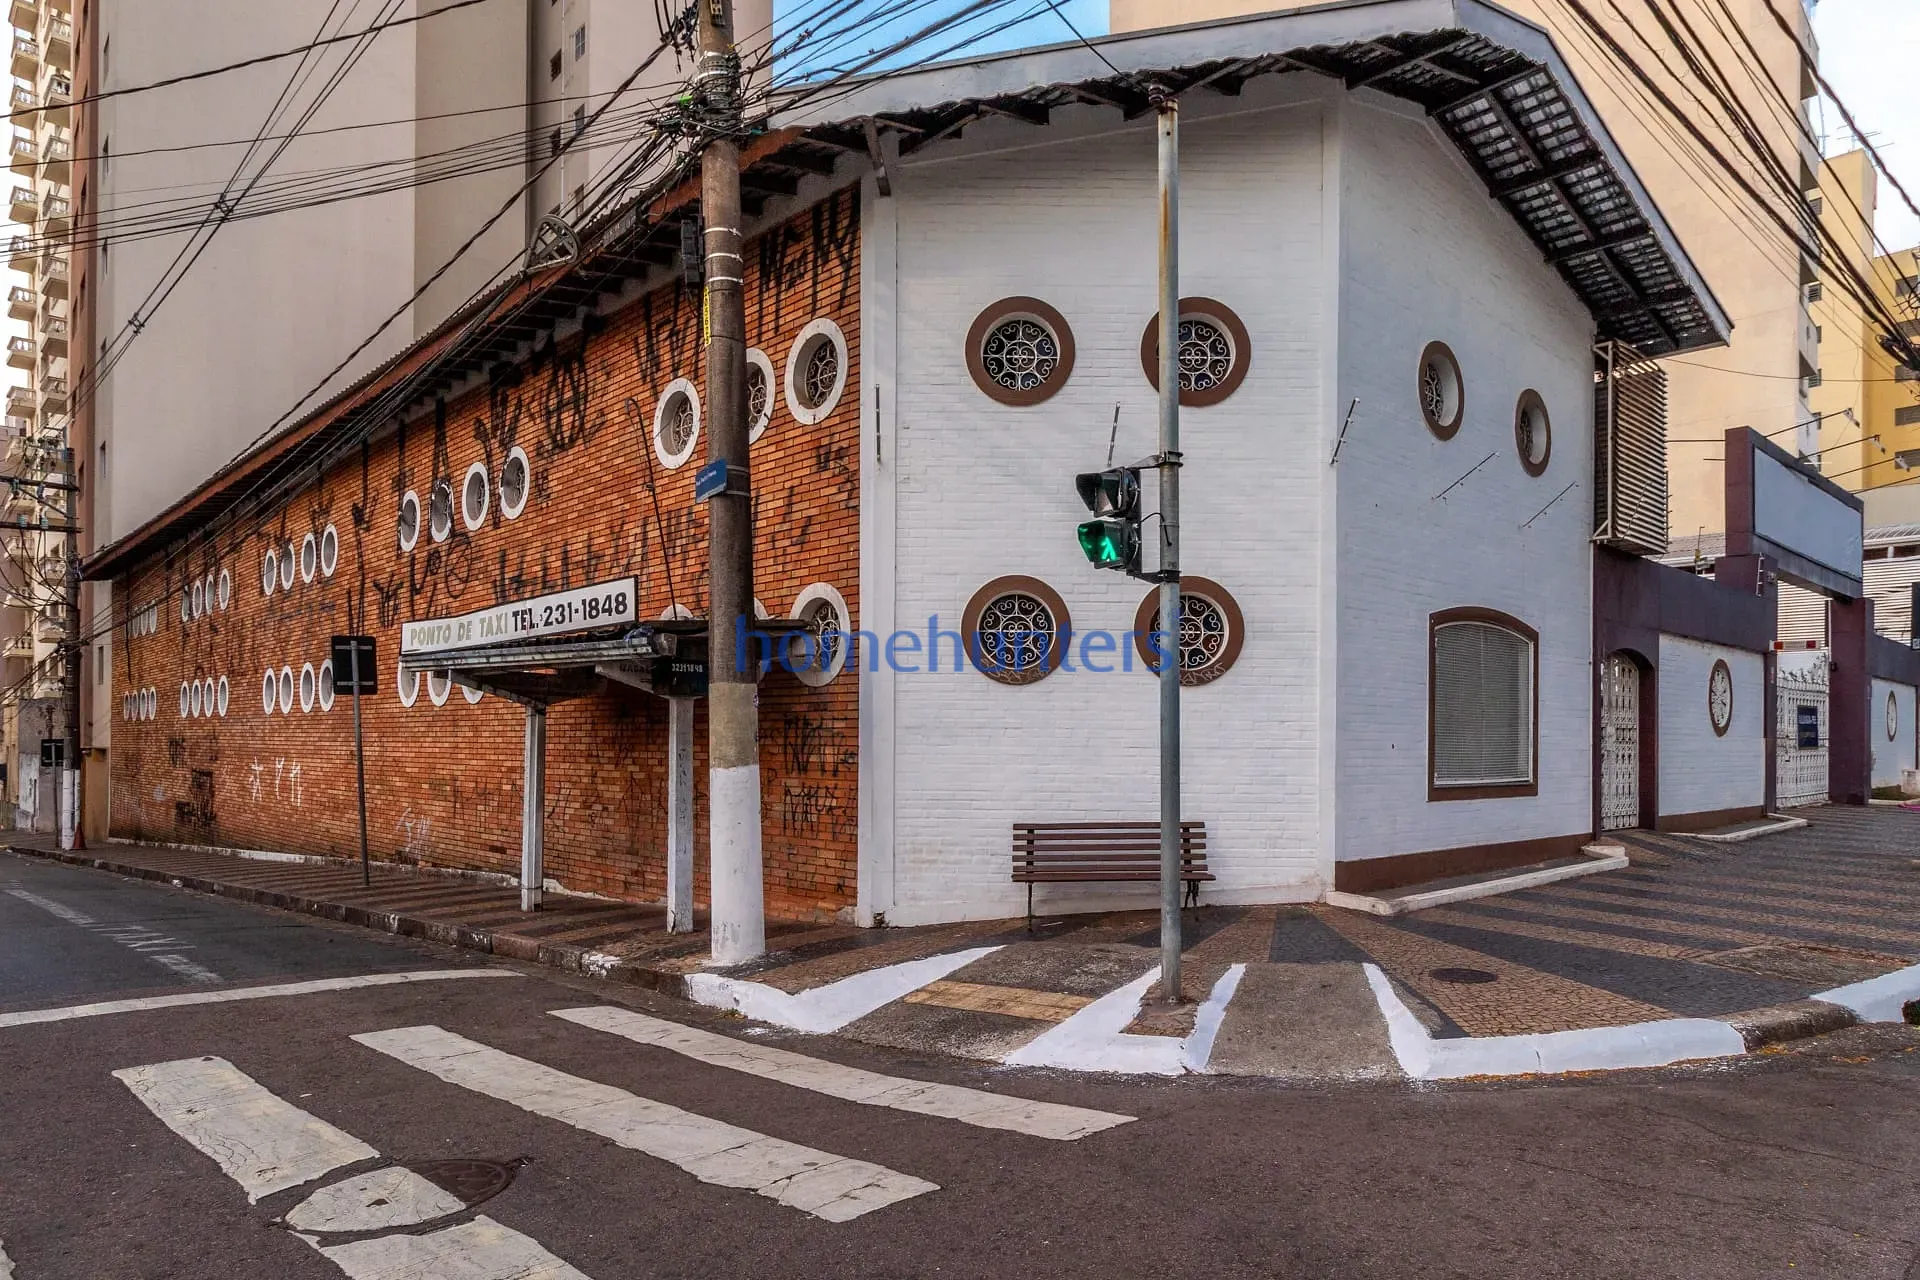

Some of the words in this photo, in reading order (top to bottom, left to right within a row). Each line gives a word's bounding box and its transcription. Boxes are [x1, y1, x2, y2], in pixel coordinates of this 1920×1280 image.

[410, 623, 452, 646] PONTO
[457, 620, 473, 642] DE
[479, 612, 508, 637] TAXI
[543, 592, 628, 627] 231-1848
